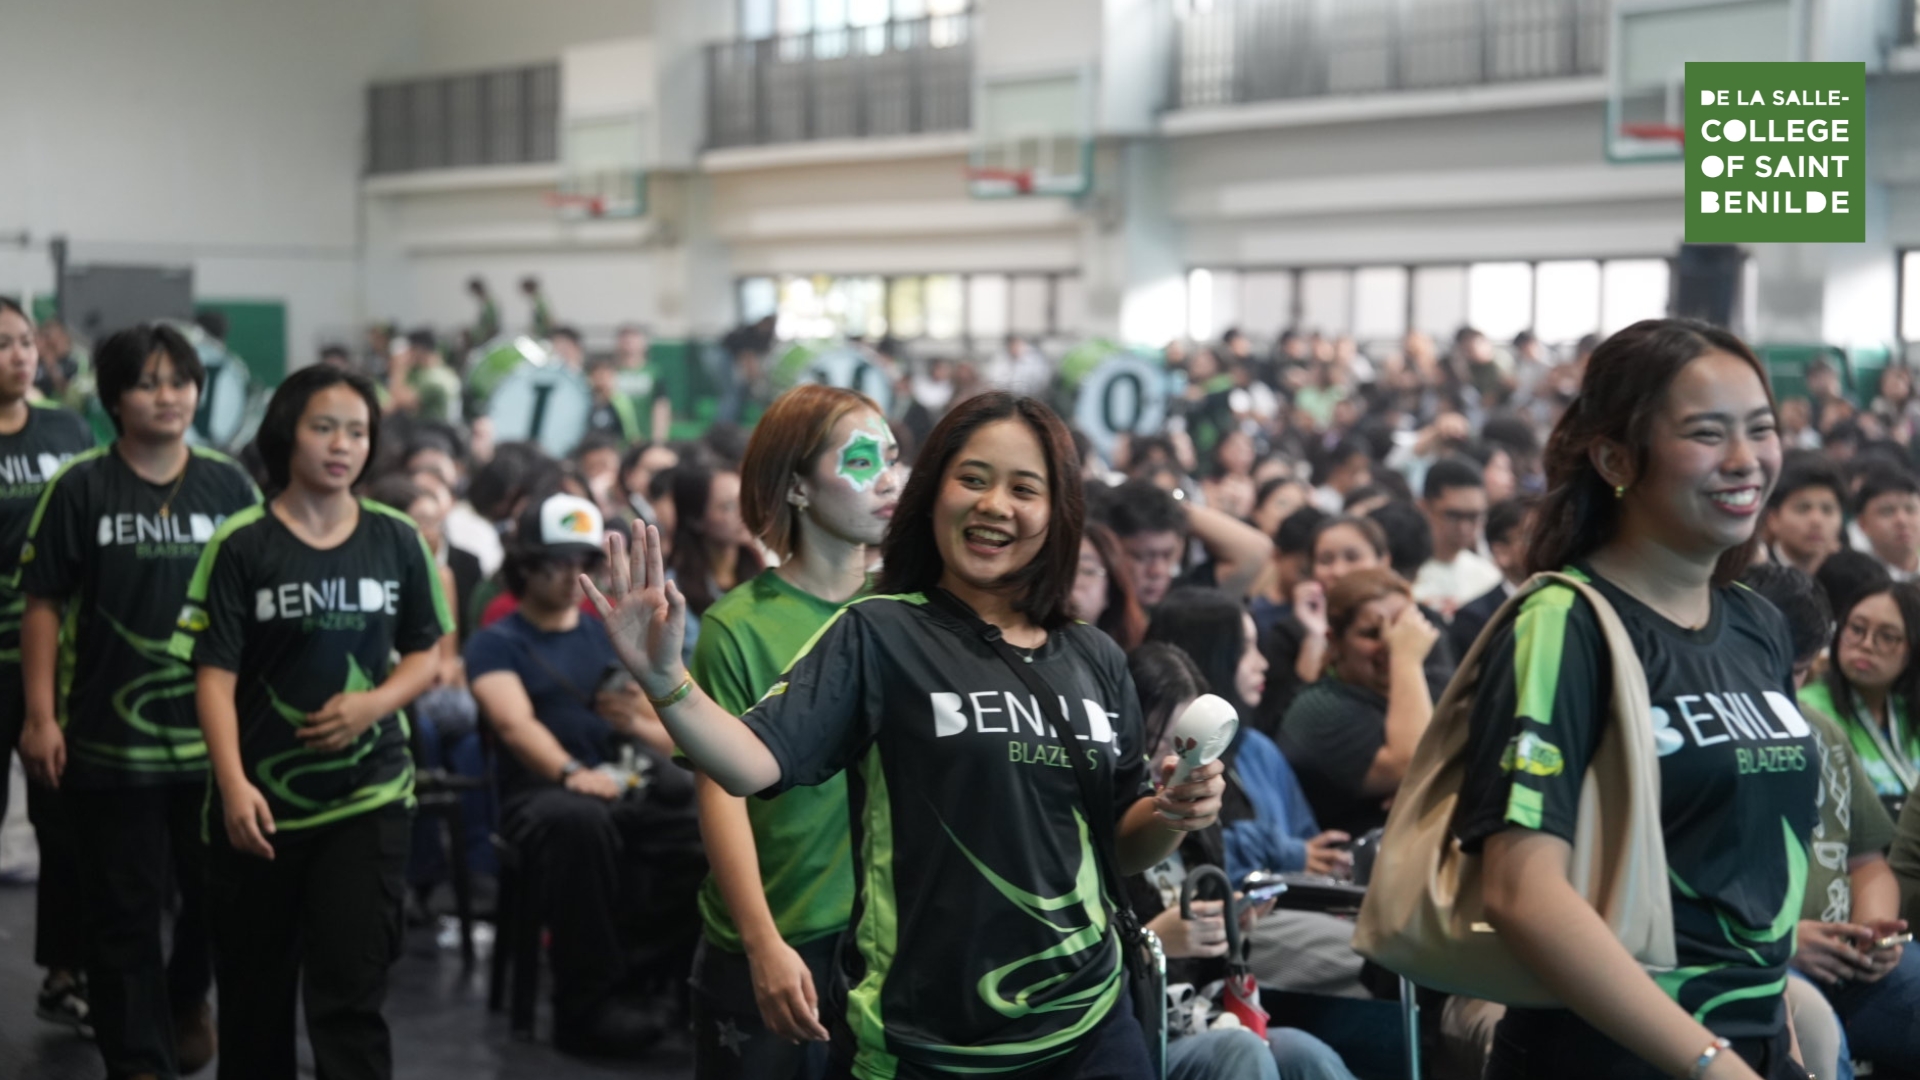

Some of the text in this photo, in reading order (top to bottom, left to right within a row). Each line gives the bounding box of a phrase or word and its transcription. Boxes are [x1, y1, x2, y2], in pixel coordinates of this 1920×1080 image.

[97, 512, 229, 546] BENILD
[255, 577, 400, 622] BENILDE
[1008, 741, 1098, 770] BLAZES
[1735, 745, 1807, 774] BLAZERS
